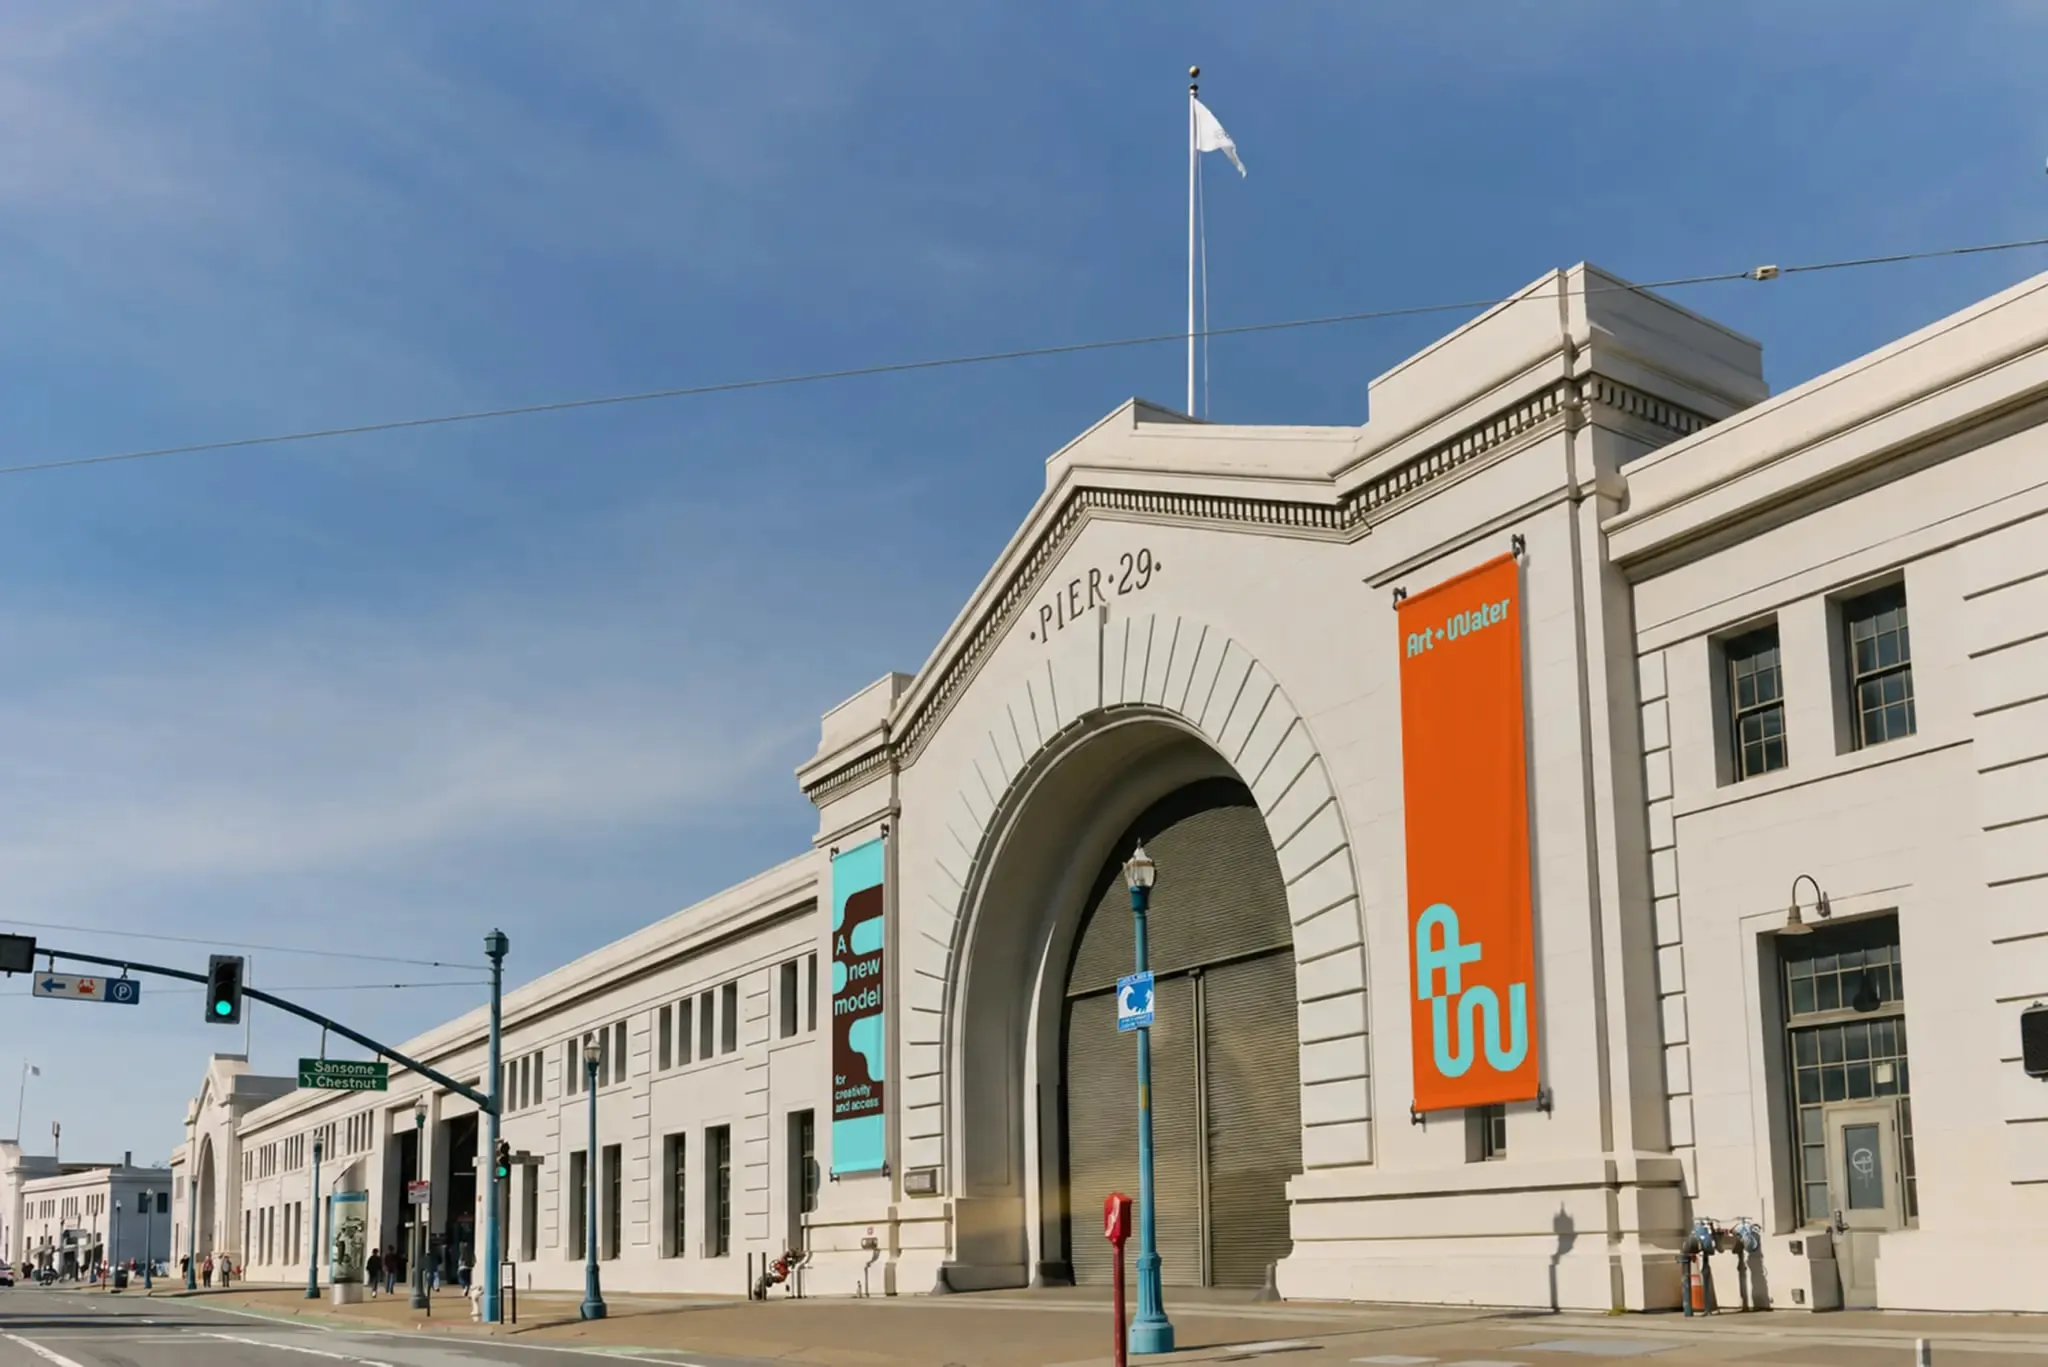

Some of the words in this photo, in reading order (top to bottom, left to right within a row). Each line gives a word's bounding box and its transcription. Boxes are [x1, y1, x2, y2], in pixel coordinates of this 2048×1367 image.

[1039, 567, 1106, 643] PIER
[1118, 548, 1152, 595] 29
[1407, 627, 1433, 658] Art
[1447, 599, 1510, 640] Water
[836, 934, 847, 956] A
[849, 957, 880, 981] new
[834, 984, 881, 1016] model
[314, 1061, 375, 1074] Sansome
[316, 1076, 377, 1089] Chestnut
[835, 1074, 847, 1086] for
[835, 1101, 850, 1113] and
